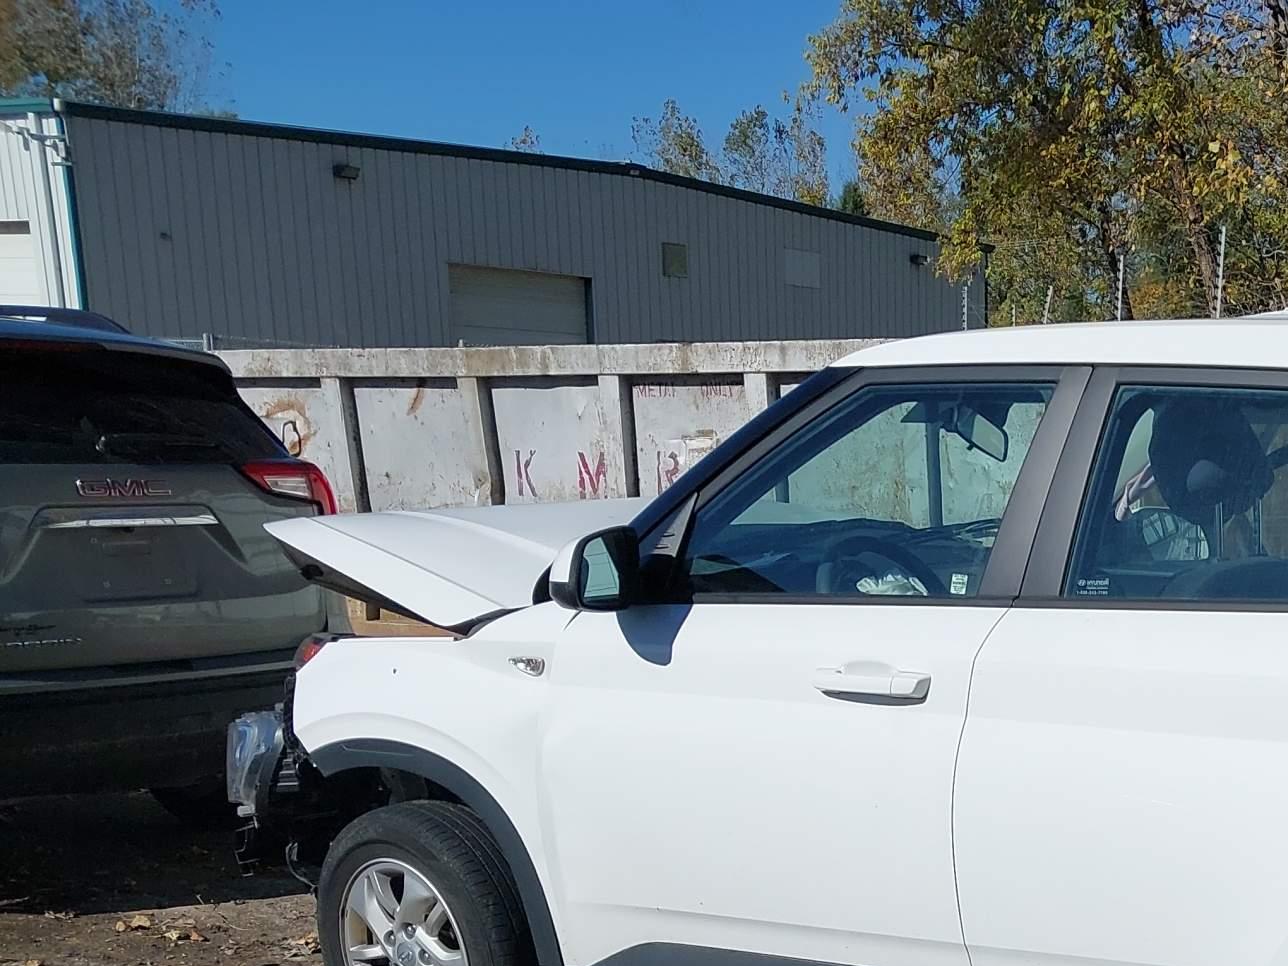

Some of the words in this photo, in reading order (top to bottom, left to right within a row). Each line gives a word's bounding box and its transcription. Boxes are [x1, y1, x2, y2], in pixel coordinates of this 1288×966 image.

[76, 479, 172, 497] GMC
[514, 450, 537, 497] K
[577, 451, 608, 500] M
